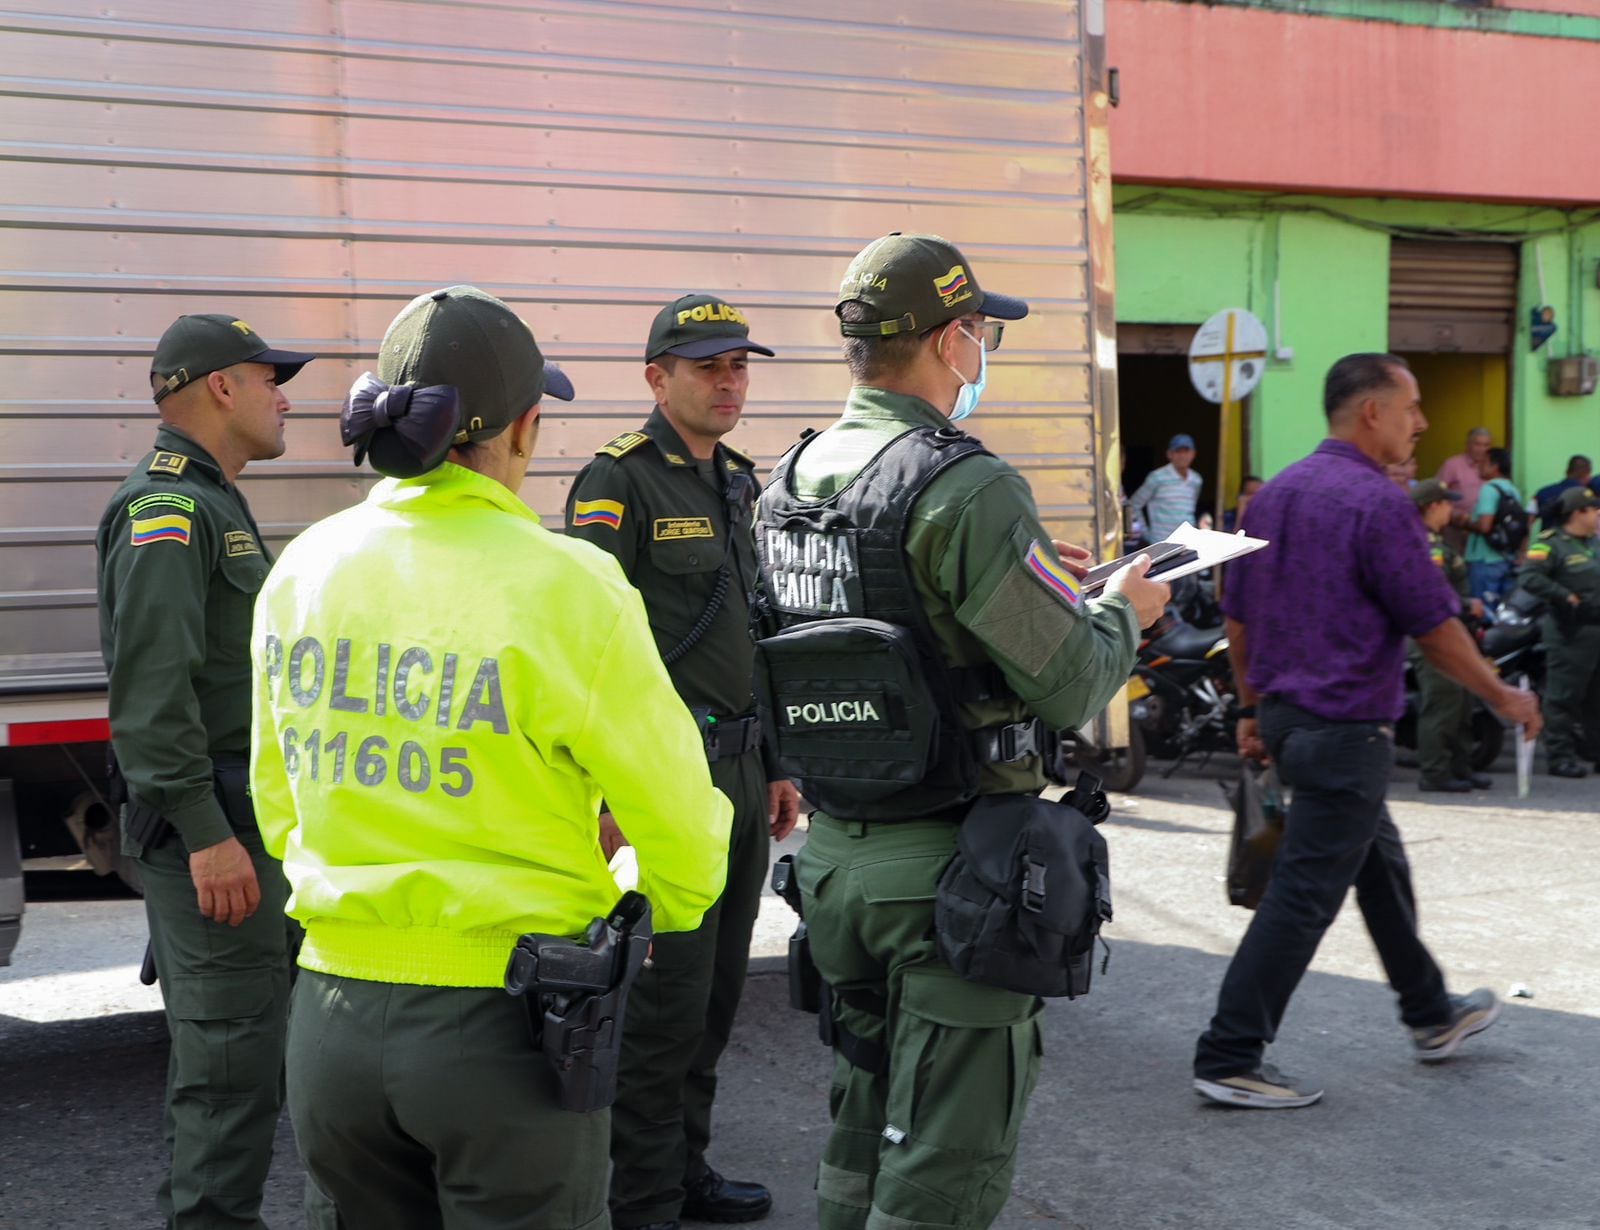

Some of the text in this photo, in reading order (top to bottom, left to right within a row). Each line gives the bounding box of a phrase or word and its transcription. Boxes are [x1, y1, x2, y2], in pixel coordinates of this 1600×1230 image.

[842, 272, 888, 291] OLICIA
[767, 529, 853, 572] POLICIA
[266, 634, 510, 735] POLICIA
[786, 701, 880, 725] POLICIA
[284, 726, 474, 798] 611605
